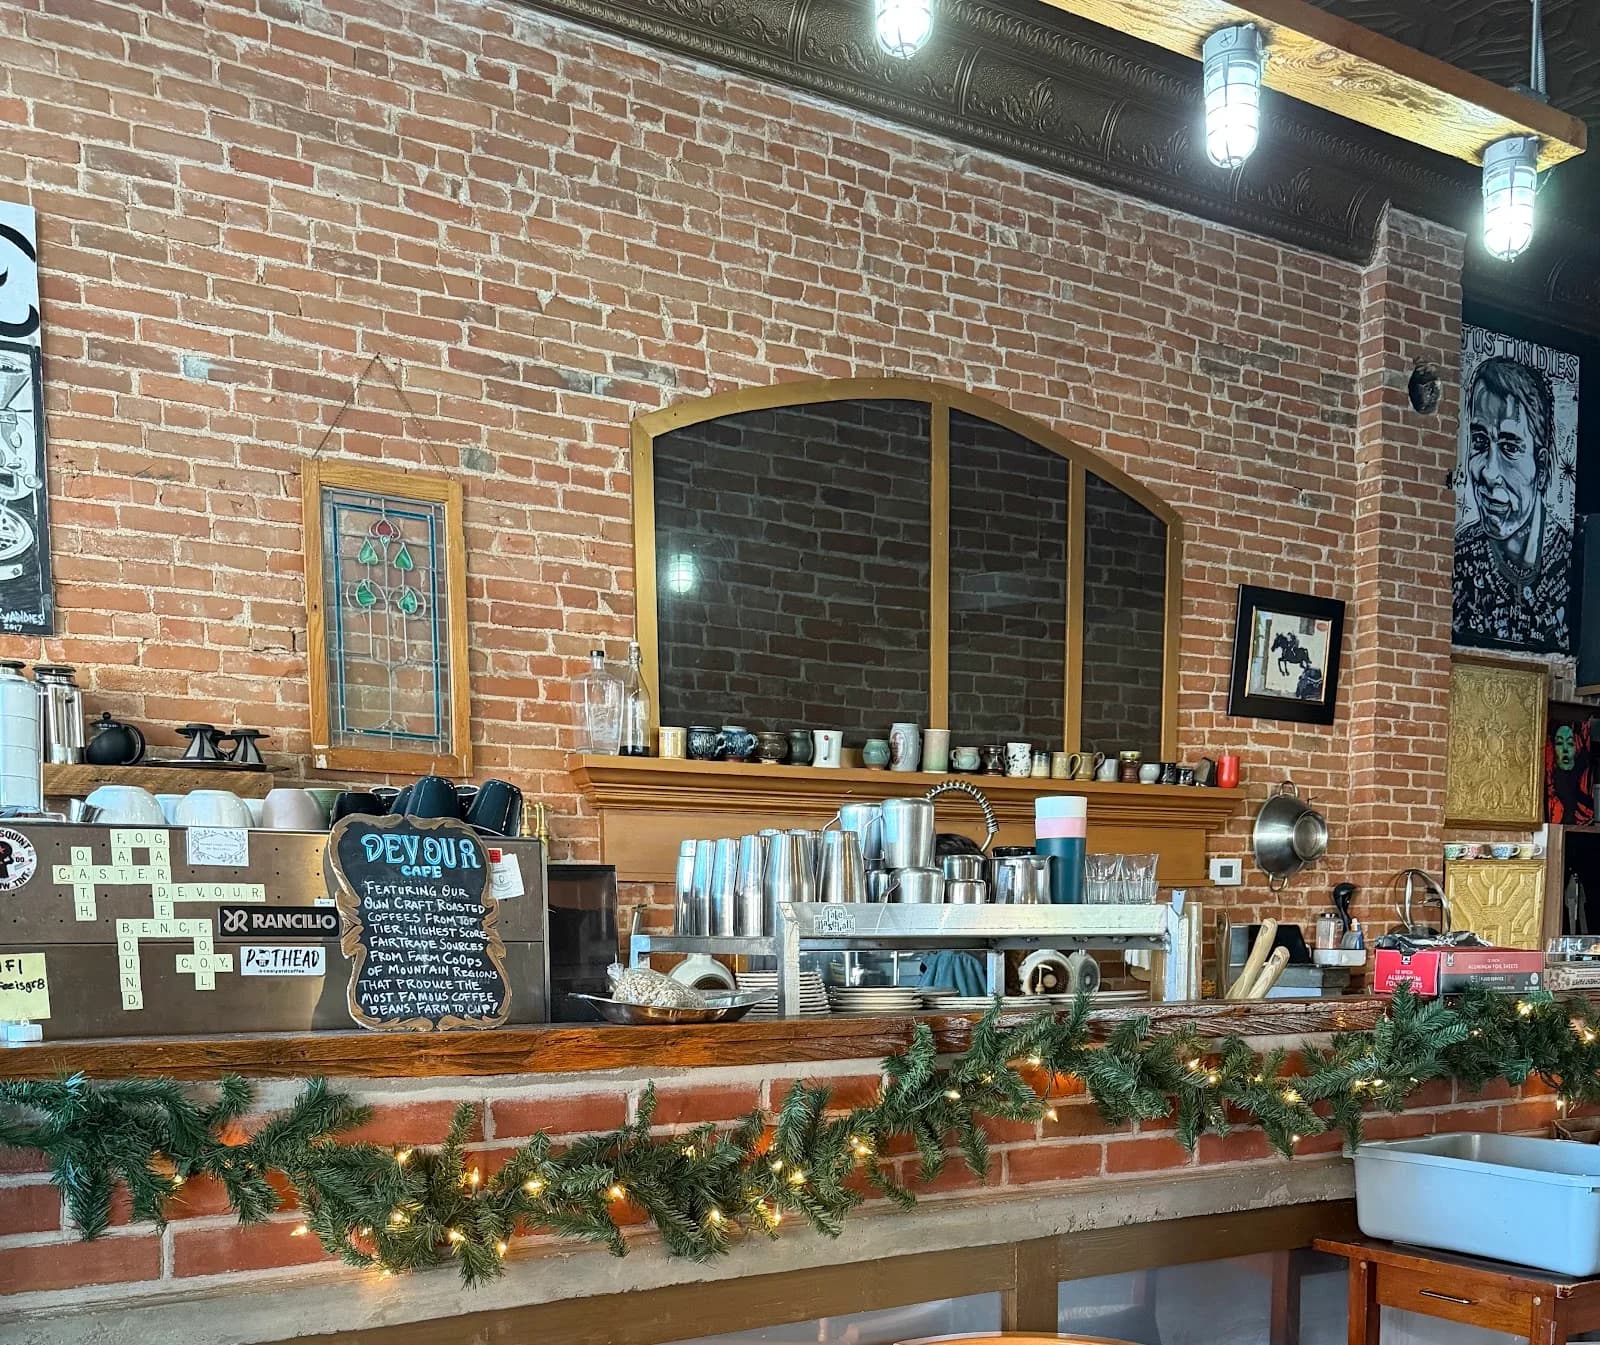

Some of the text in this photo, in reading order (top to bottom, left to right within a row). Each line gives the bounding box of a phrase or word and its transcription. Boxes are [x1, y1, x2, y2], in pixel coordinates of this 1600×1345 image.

[361, 833, 482, 869] DEVOUR
[401, 864, 443, 879] CAFE
[364, 880, 470, 898] FEATURING OUR
[363, 896, 486, 915] OWN CRAFT ROASTED
[252, 913, 337, 930] RANCILIO
[367, 911, 478, 926] COFFEES FROM TOP
[409, 925, 458, 938] HIGHEST
[439, 938, 485, 951] SOURCES
[369, 950, 404, 963] FROM
[407, 950, 441, 963] FARM
[367, 964, 499, 980] OF MOUNTAIN REGIONS
[359, 979, 483, 991] THAT PRODUCE THE
[361, 991, 497, 1005] MOST FAMOUS COFFEE
[416, 1002, 451, 1014] FARM
[452, 1004, 464, 1014] TO
[467, 1002, 499, 1015] CUP!
